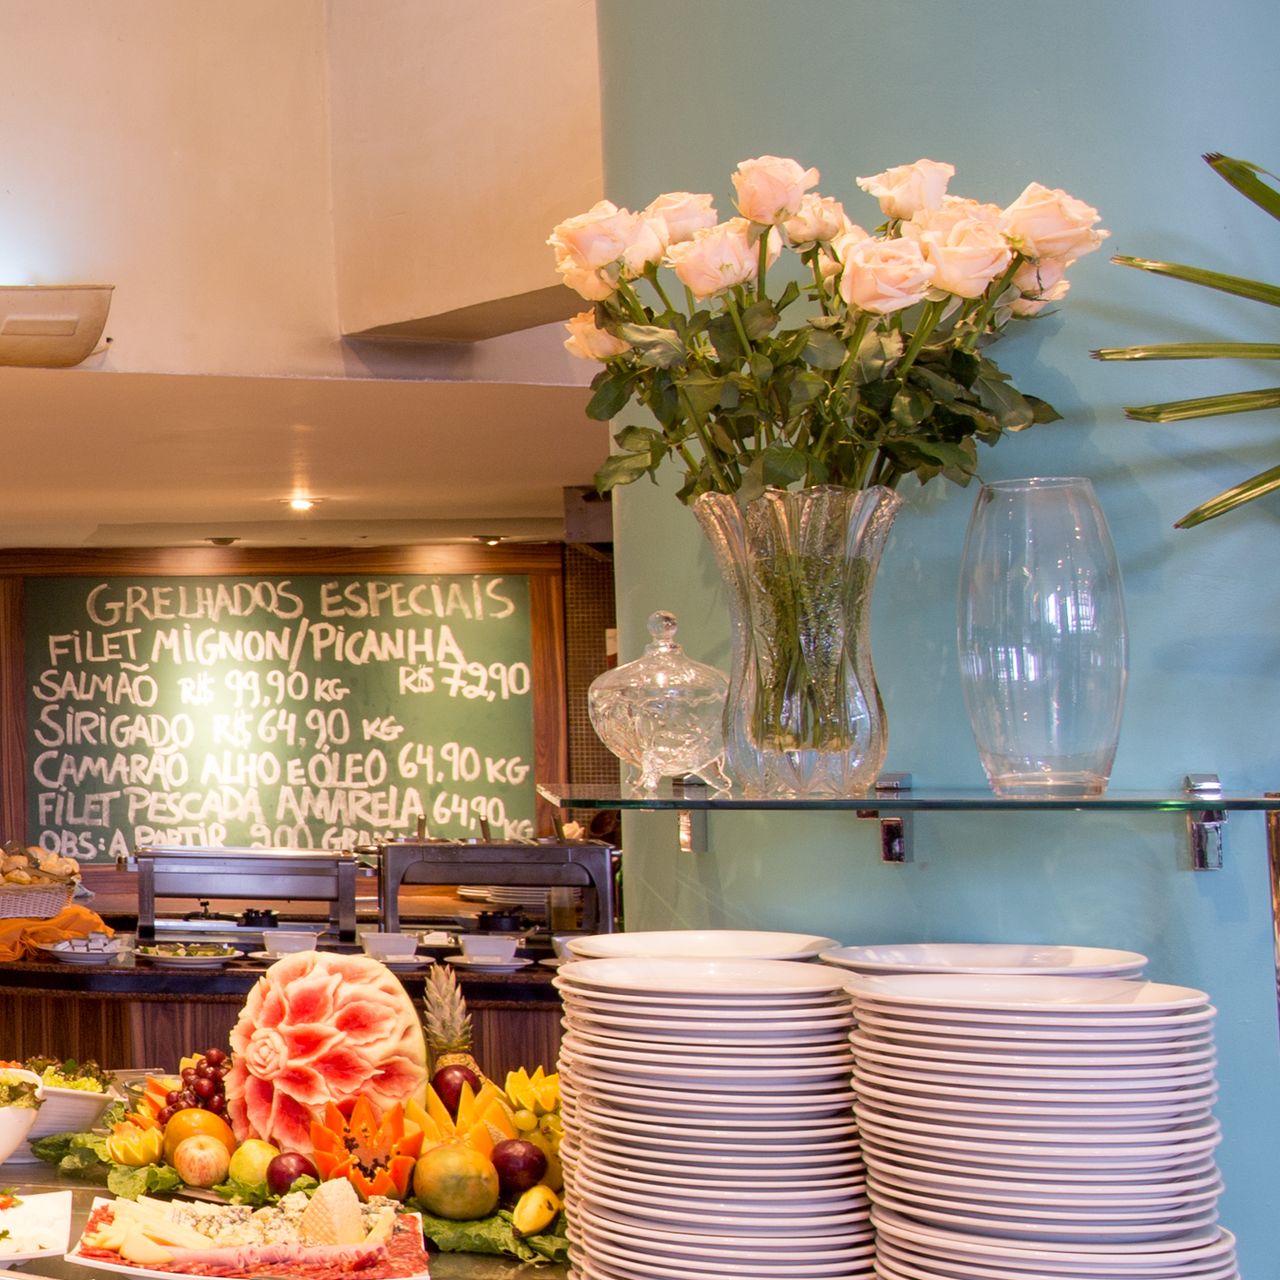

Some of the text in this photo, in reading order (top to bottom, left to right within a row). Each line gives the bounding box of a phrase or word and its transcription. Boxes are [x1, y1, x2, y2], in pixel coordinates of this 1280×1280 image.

[87, 575, 515, 627] GRELHADOS ESPECIAIS
[48, 627, 142, 666] FILET
[33, 662, 350, 708] SALMÃO R$ 99,90 KG
[399, 661, 531, 702] R$ 72,90
[34, 704, 404, 750] SIRIGADO R$ 64,90 KG
[33, 745, 189, 792] CAMARÃO
[200, 751, 281, 786] ALHO
[287, 757, 307, 785] E
[398, 741, 481, 784] 64,90
[485, 756, 530, 785] KG
[38, 783, 535, 841] FILET PESCADA AMARELA 64,90 KG
